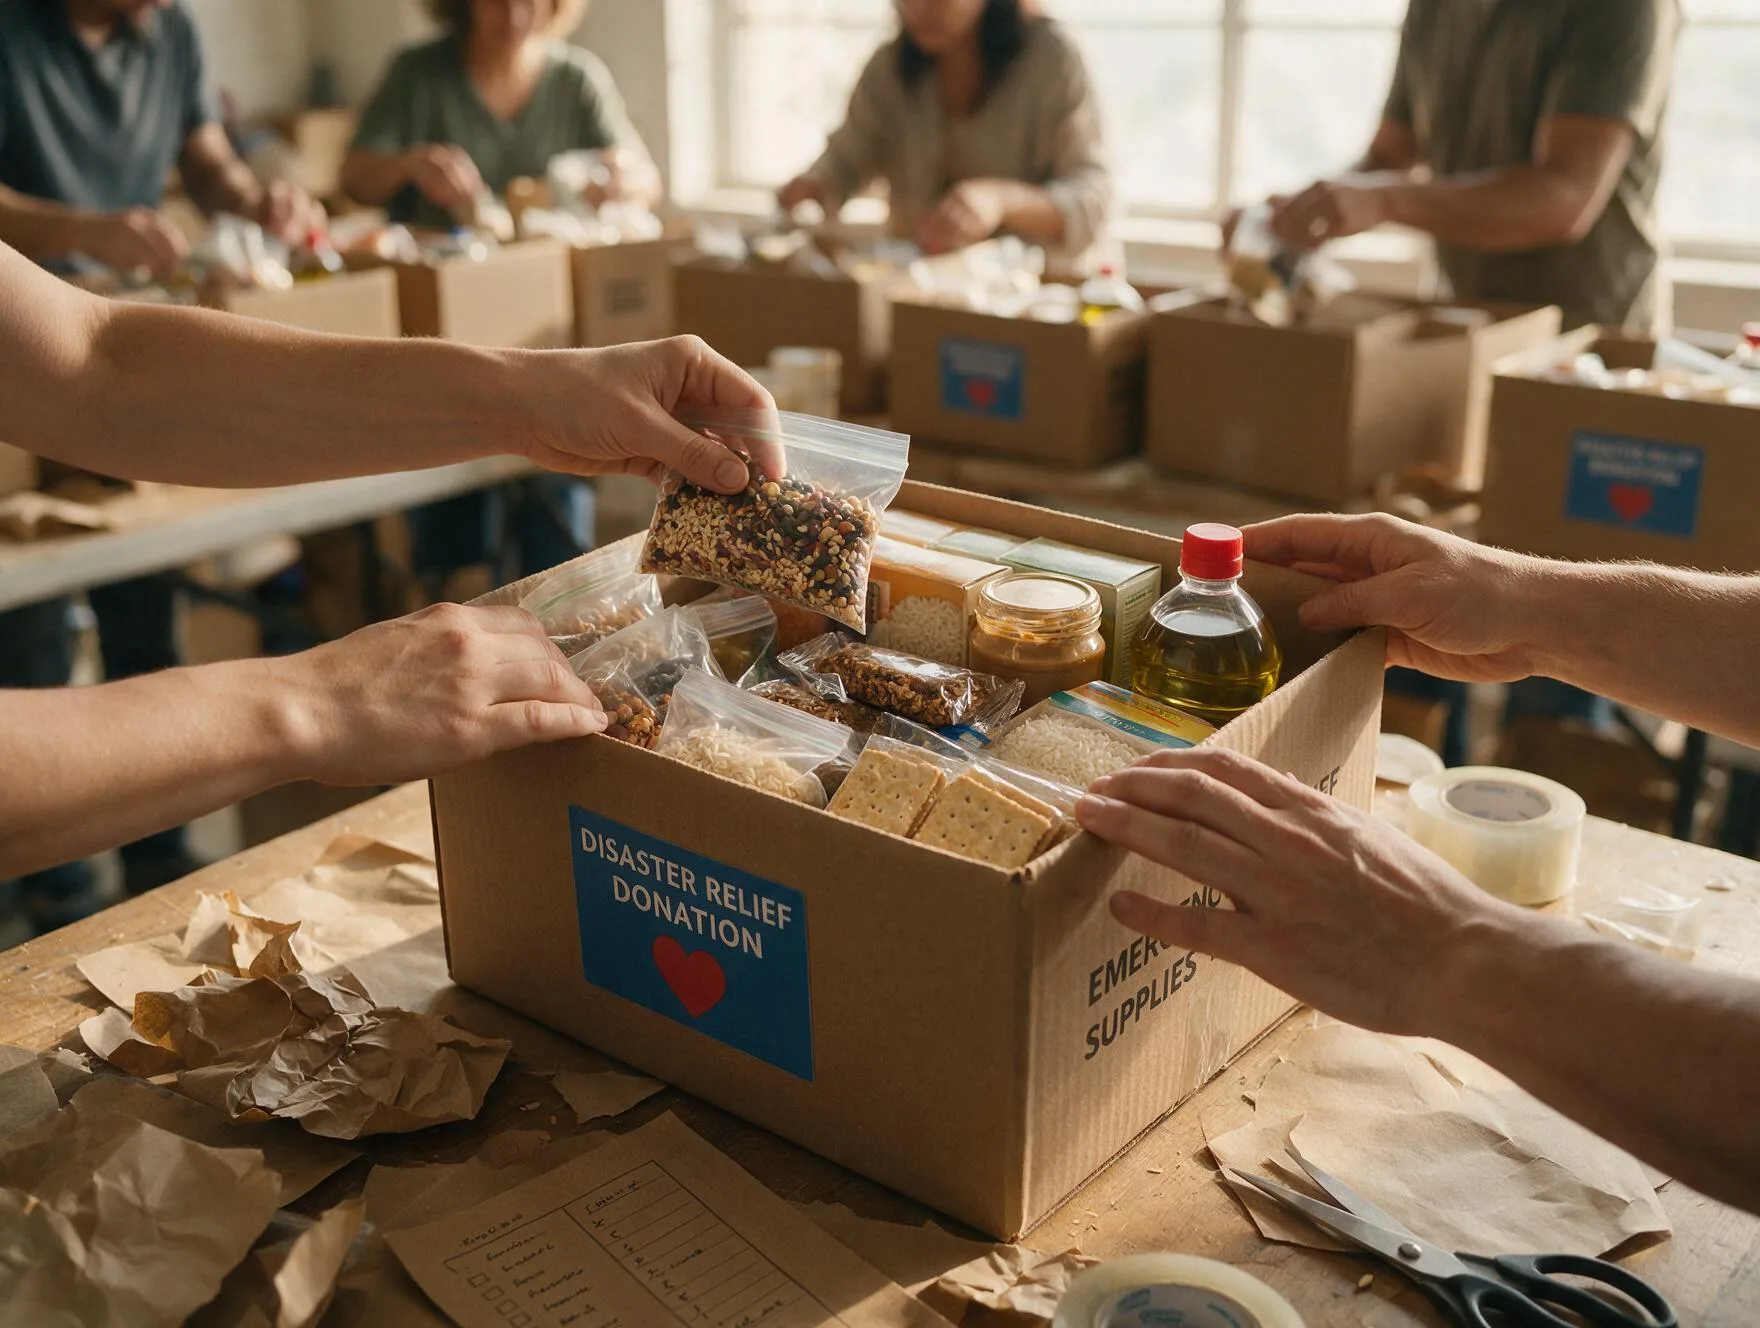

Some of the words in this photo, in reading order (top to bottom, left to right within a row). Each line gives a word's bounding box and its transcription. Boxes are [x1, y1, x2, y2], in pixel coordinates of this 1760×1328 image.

[581, 827, 697, 896] DISASTER
[705, 875, 792, 930] RELIEF
[612, 874, 763, 959] DONATION
[1084, 951, 1197, 1060] SUPPLIES
